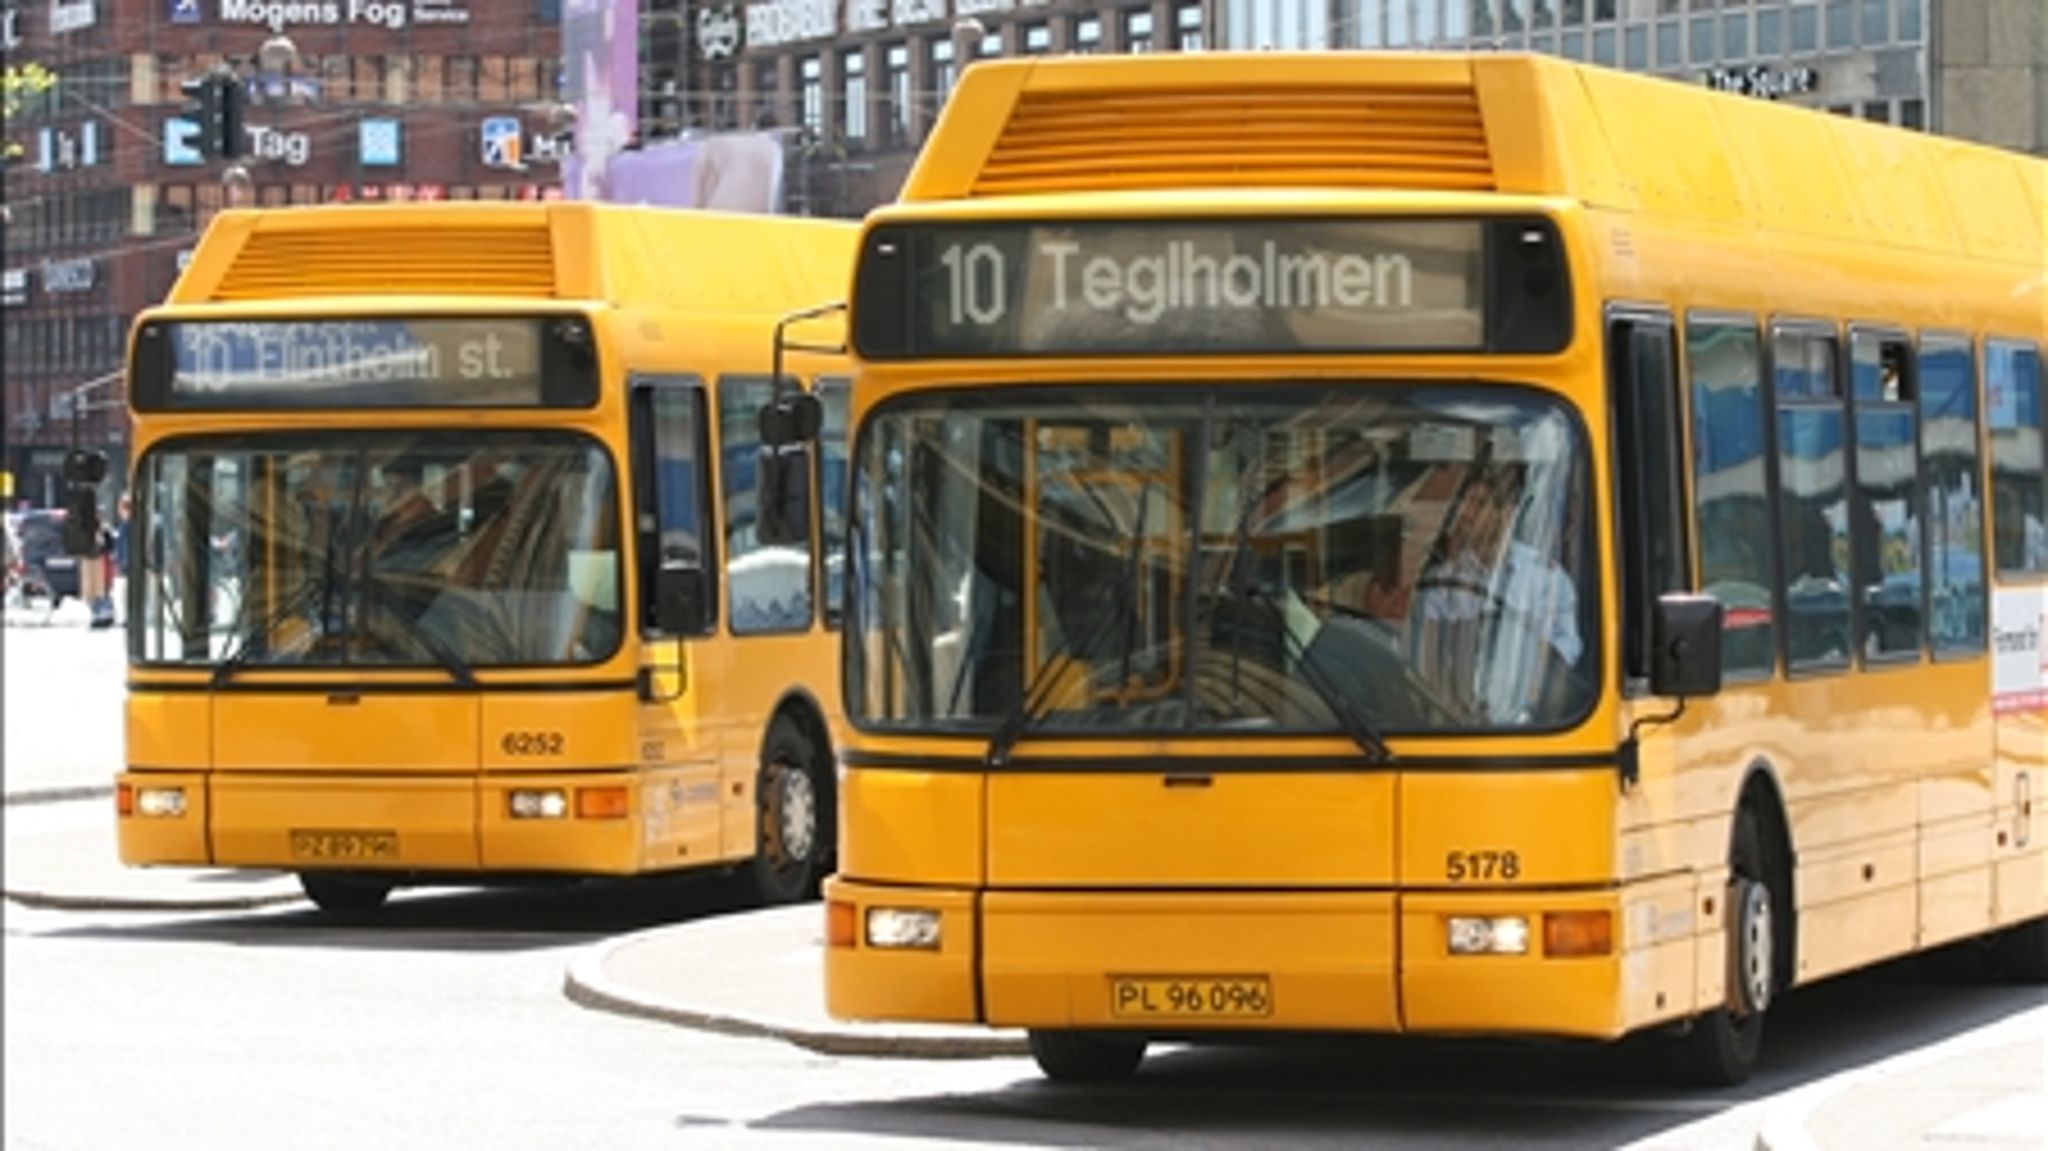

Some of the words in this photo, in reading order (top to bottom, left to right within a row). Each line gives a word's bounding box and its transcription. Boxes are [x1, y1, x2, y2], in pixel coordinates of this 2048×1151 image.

[221, 0, 338, 32] Mogens
[349, 0, 405, 29] Fog
[244, 126, 309, 165] Tag
[942, 244, 1006, 325] 10
[1040, 240, 1412, 323] Teglholmen
[192, 336, 233, 392] 10
[458, 332, 515, 379] st.
[501, 732, 565, 756] 6252
[1445, 850, 1521, 880] 5178
[1118, 983, 1158, 1011] PL
[1165, 982, 1204, 1011] 96
[1210, 982, 1267, 1011] 096
